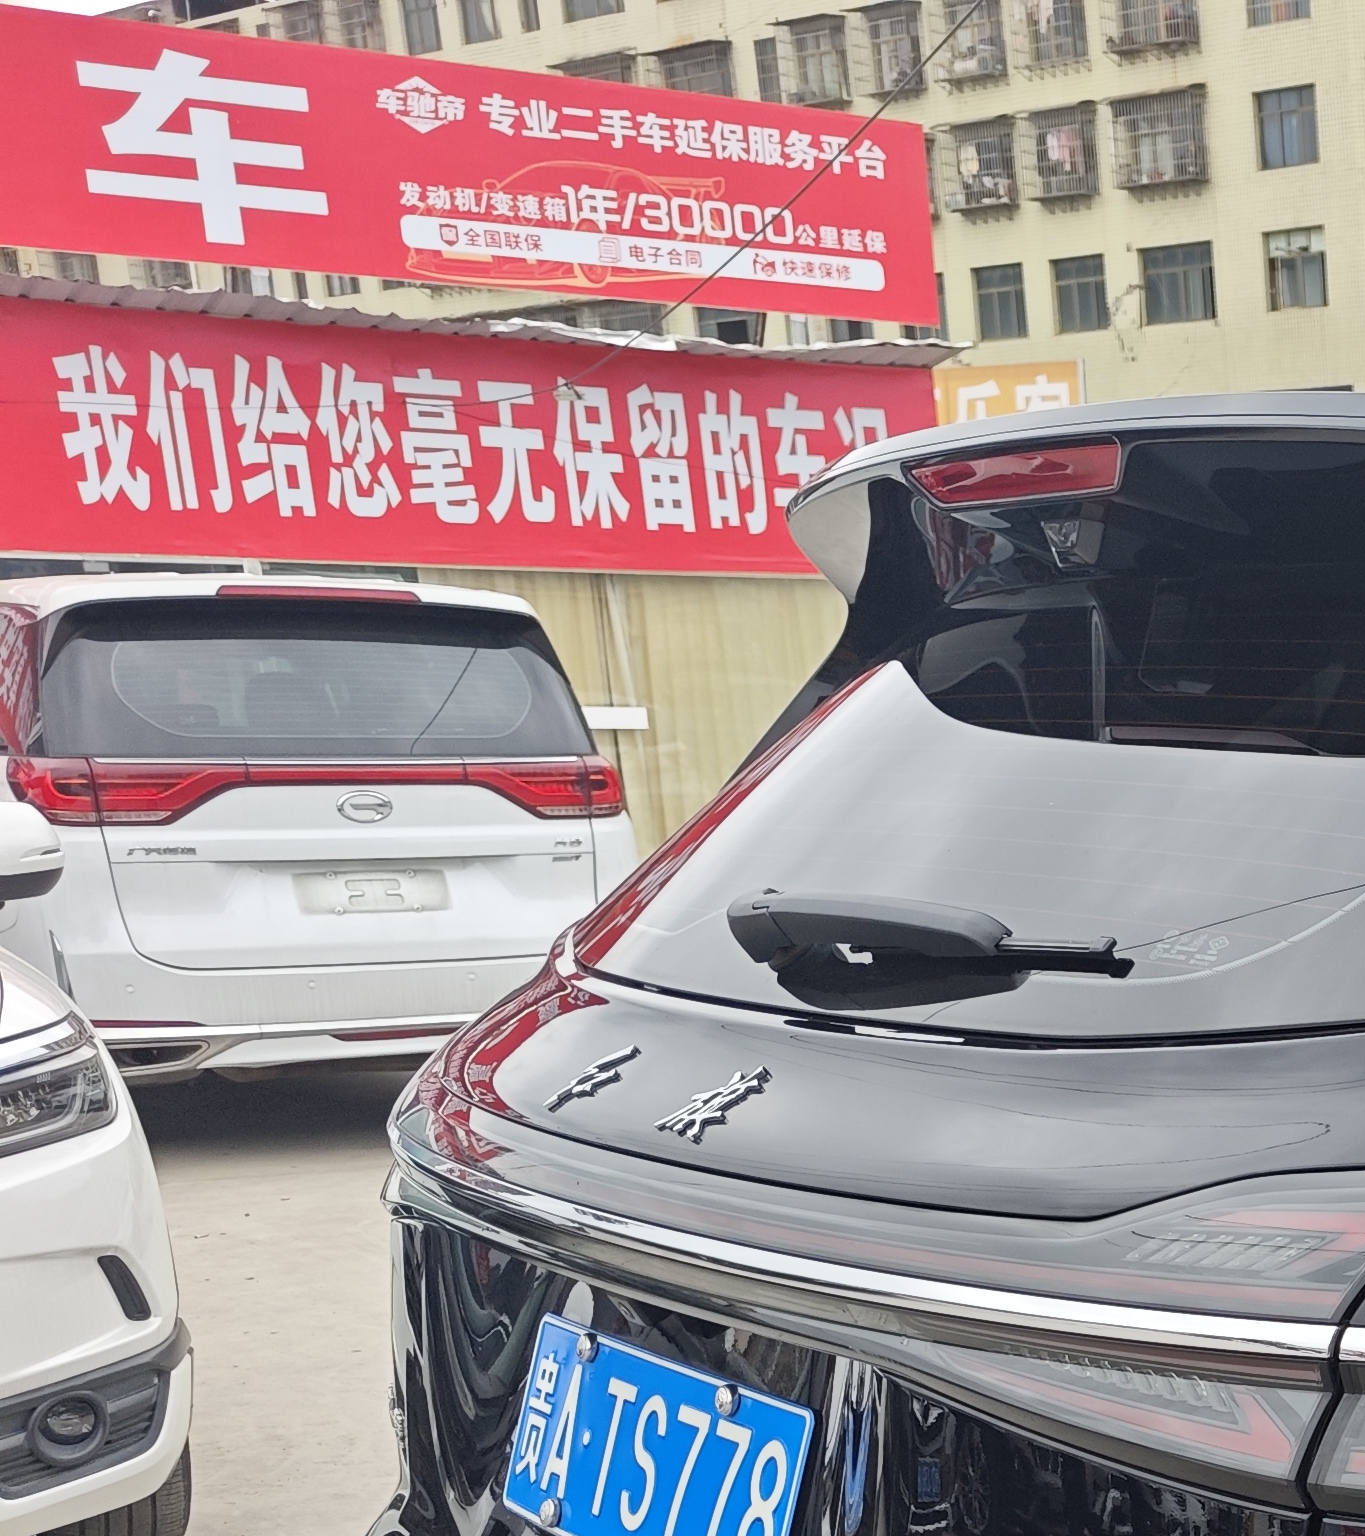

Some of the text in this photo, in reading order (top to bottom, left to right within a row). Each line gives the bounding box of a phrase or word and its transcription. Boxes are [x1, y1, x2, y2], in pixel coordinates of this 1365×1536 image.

[375, 88, 466, 121] 车驰帝
[75, 48, 329, 245] 车
[478, 93, 888, 180] 专业二手车延保服务平台
[463, 227, 544, 253] 全国联保
[628, 244, 703, 269] 电子合同
[782, 257, 852, 282] 快速保修
